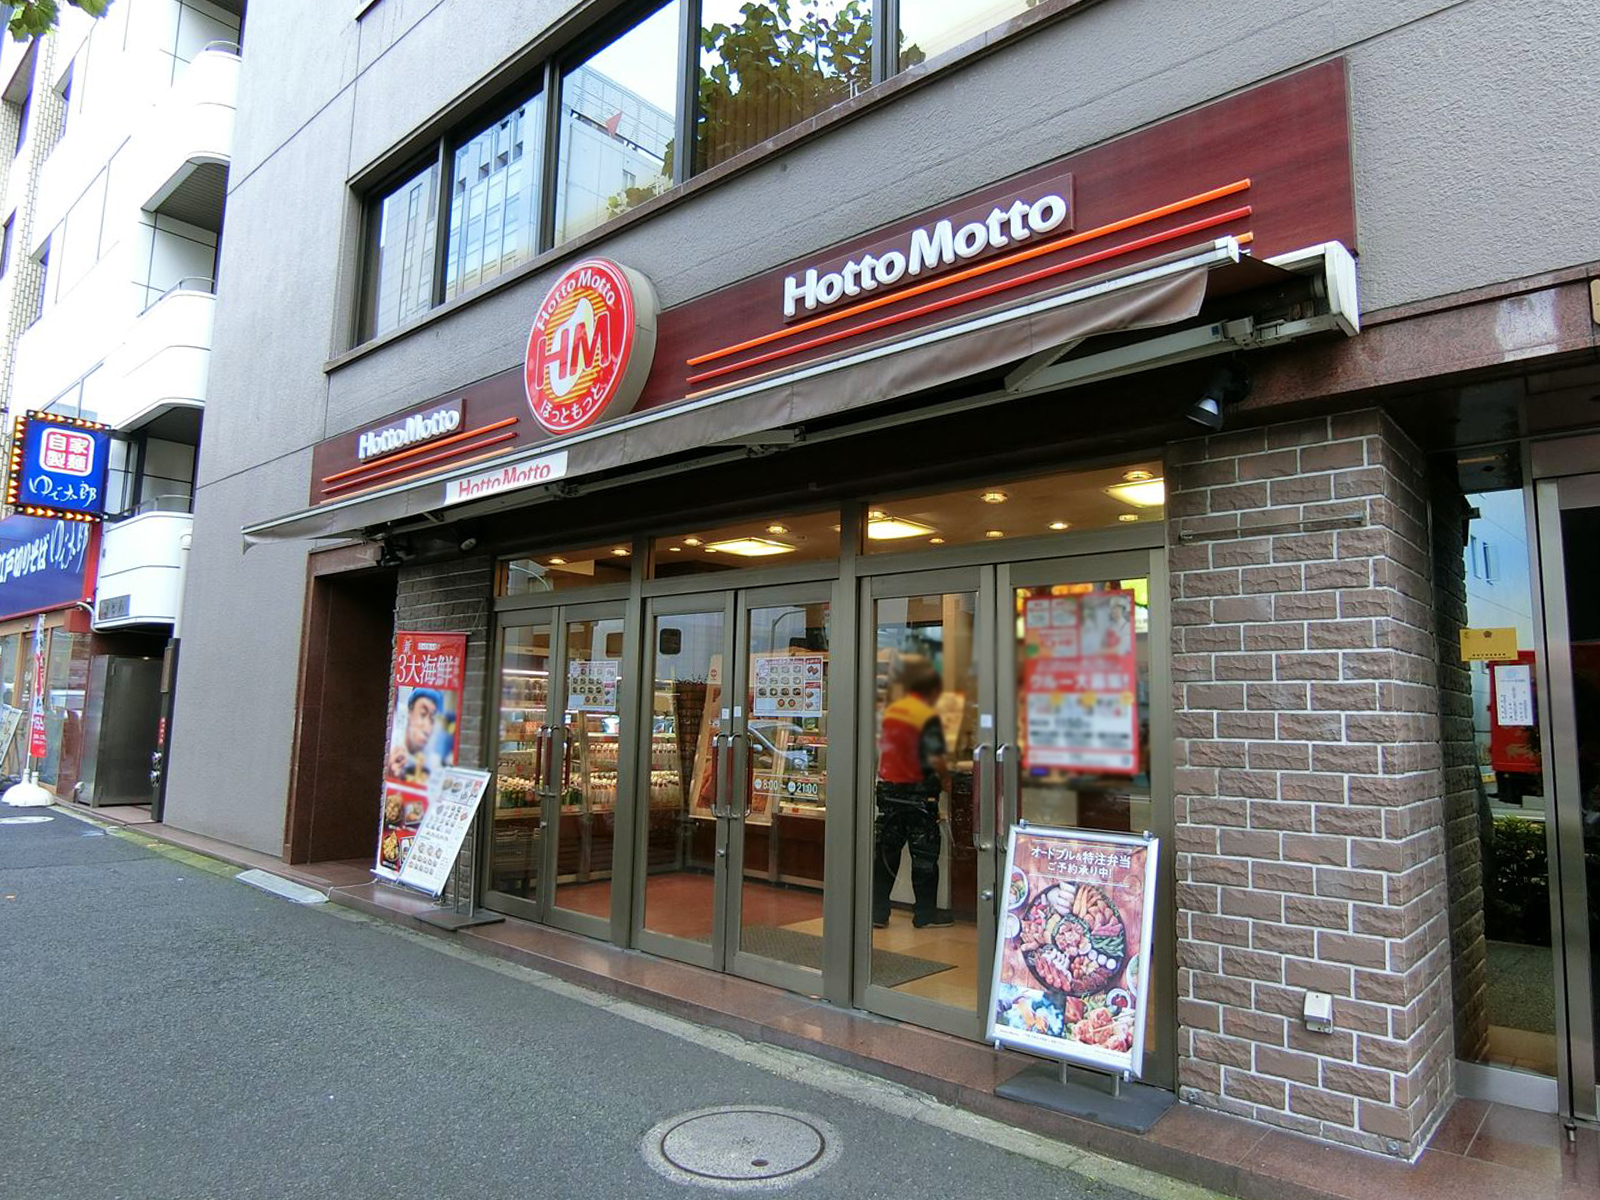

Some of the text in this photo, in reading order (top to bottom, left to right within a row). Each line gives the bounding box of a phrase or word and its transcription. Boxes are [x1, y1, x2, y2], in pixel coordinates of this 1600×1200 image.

[540, 384, 607, 424] ほっともっと
[28, 474, 97, 508] ゆで太郎
[396, 653, 454, 688] 3大海鮮
[762, 779, 779, 791] 8:00
[796, 782, 818, 795] 21:00
[1047, 861, 1112, 878] ご予約承り中!
